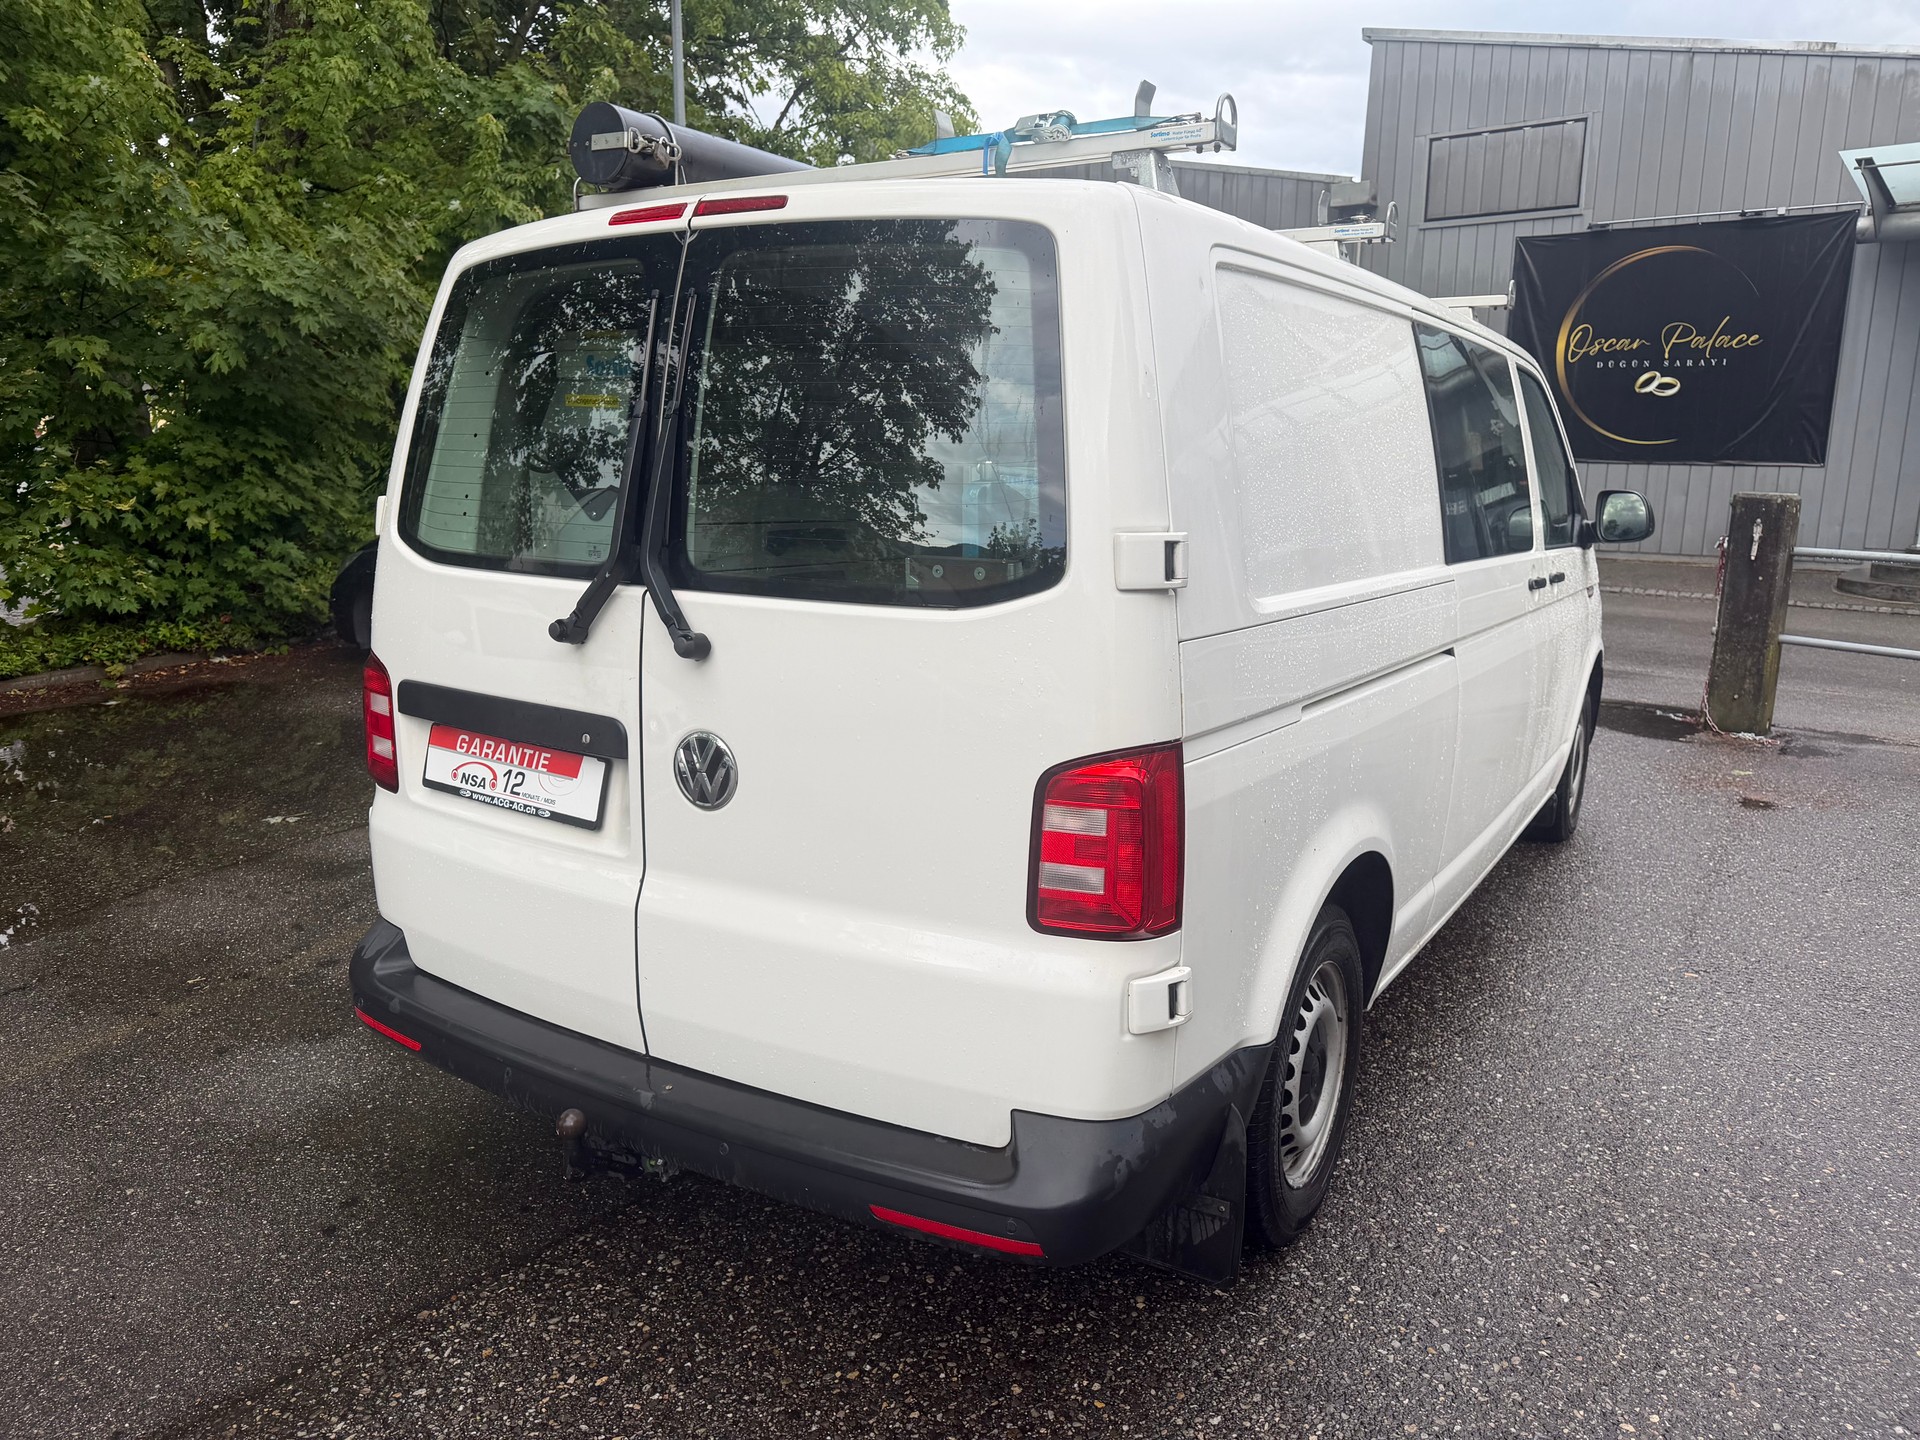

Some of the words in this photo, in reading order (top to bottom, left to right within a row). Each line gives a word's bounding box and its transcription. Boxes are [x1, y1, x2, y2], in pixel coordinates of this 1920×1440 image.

[1567, 323, 1650, 363] Oscar
[1661, 315, 1763, 359] Palace
[456, 734, 551, 772] GARANTIE
[460, 772, 486, 789] NSA
[502, 769, 526, 796] 12
[472, 792, 536, 815] www.ACG-AG.ch
